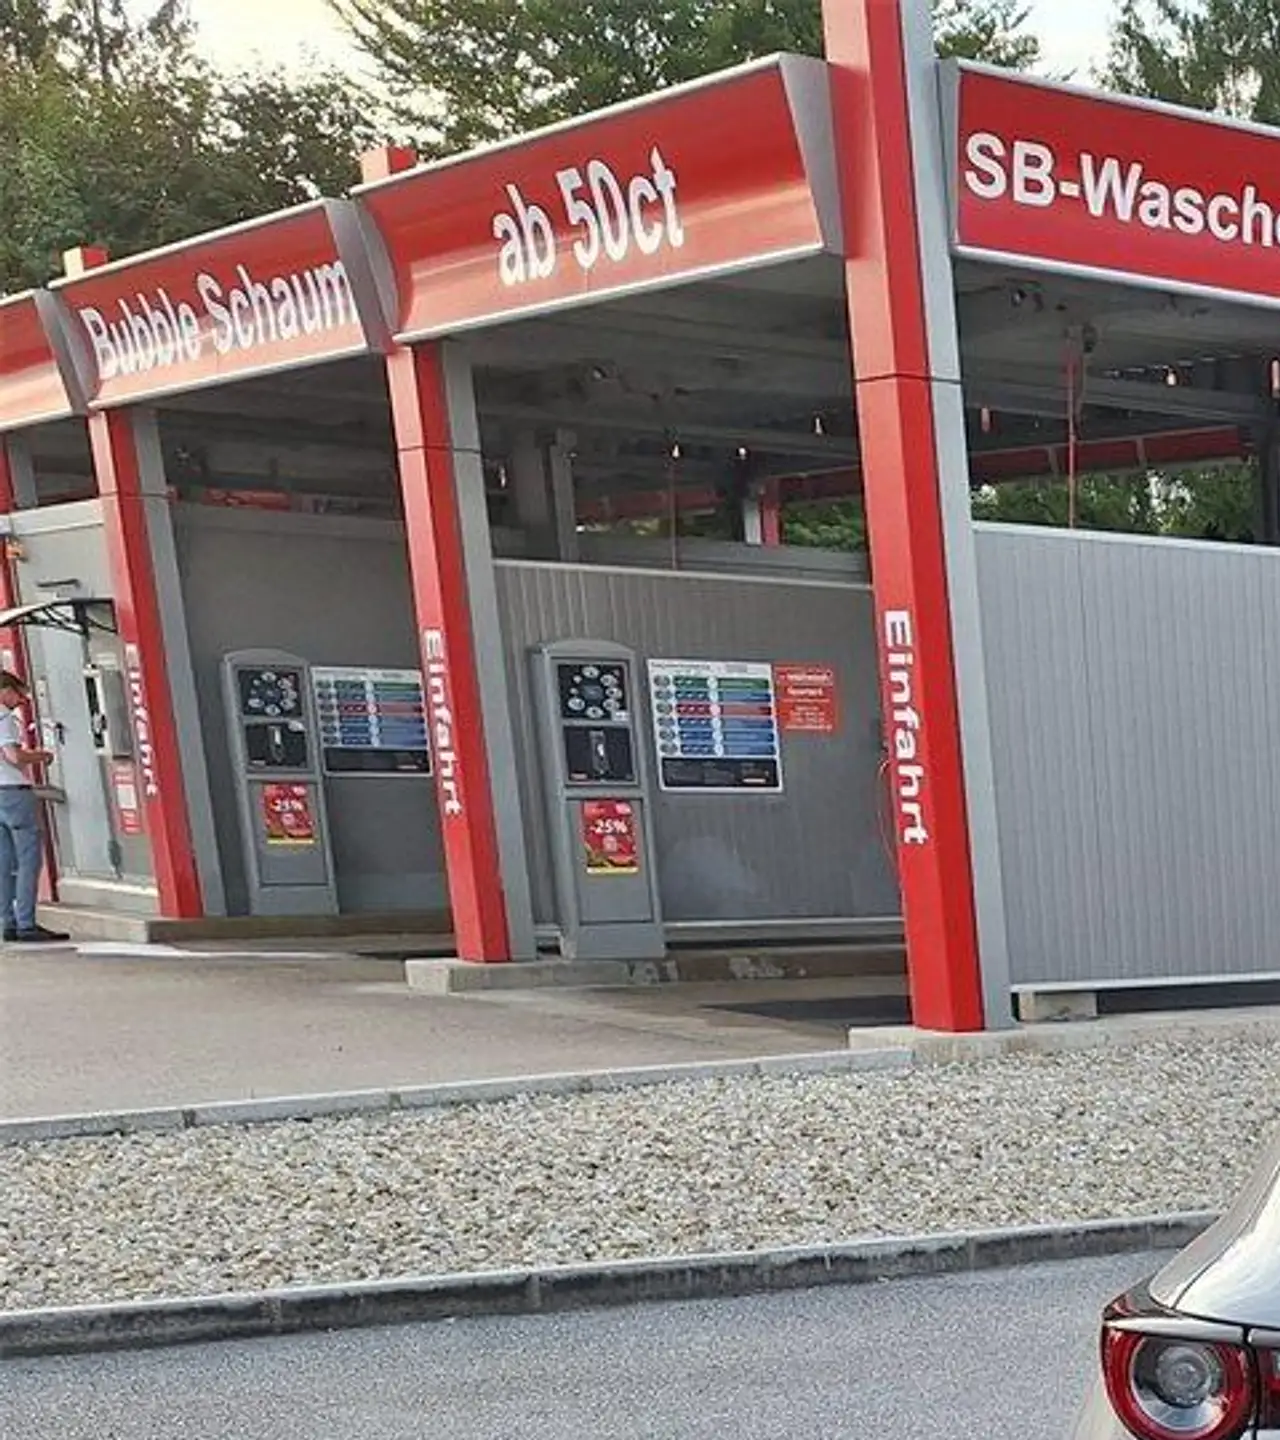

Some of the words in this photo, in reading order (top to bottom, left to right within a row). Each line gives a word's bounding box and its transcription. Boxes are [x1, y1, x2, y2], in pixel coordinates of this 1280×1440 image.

[492, 183, 556, 287] ab
[555, 145, 684, 269] 50ct
[79, 287, 200, 381] Bubble
[197, 259, 361, 354] Schaum
[125, 642, 158, 797] Einfahrt
[424, 628, 462, 815] Einfahrt
[884, 610, 929, 845] Einfahrt
